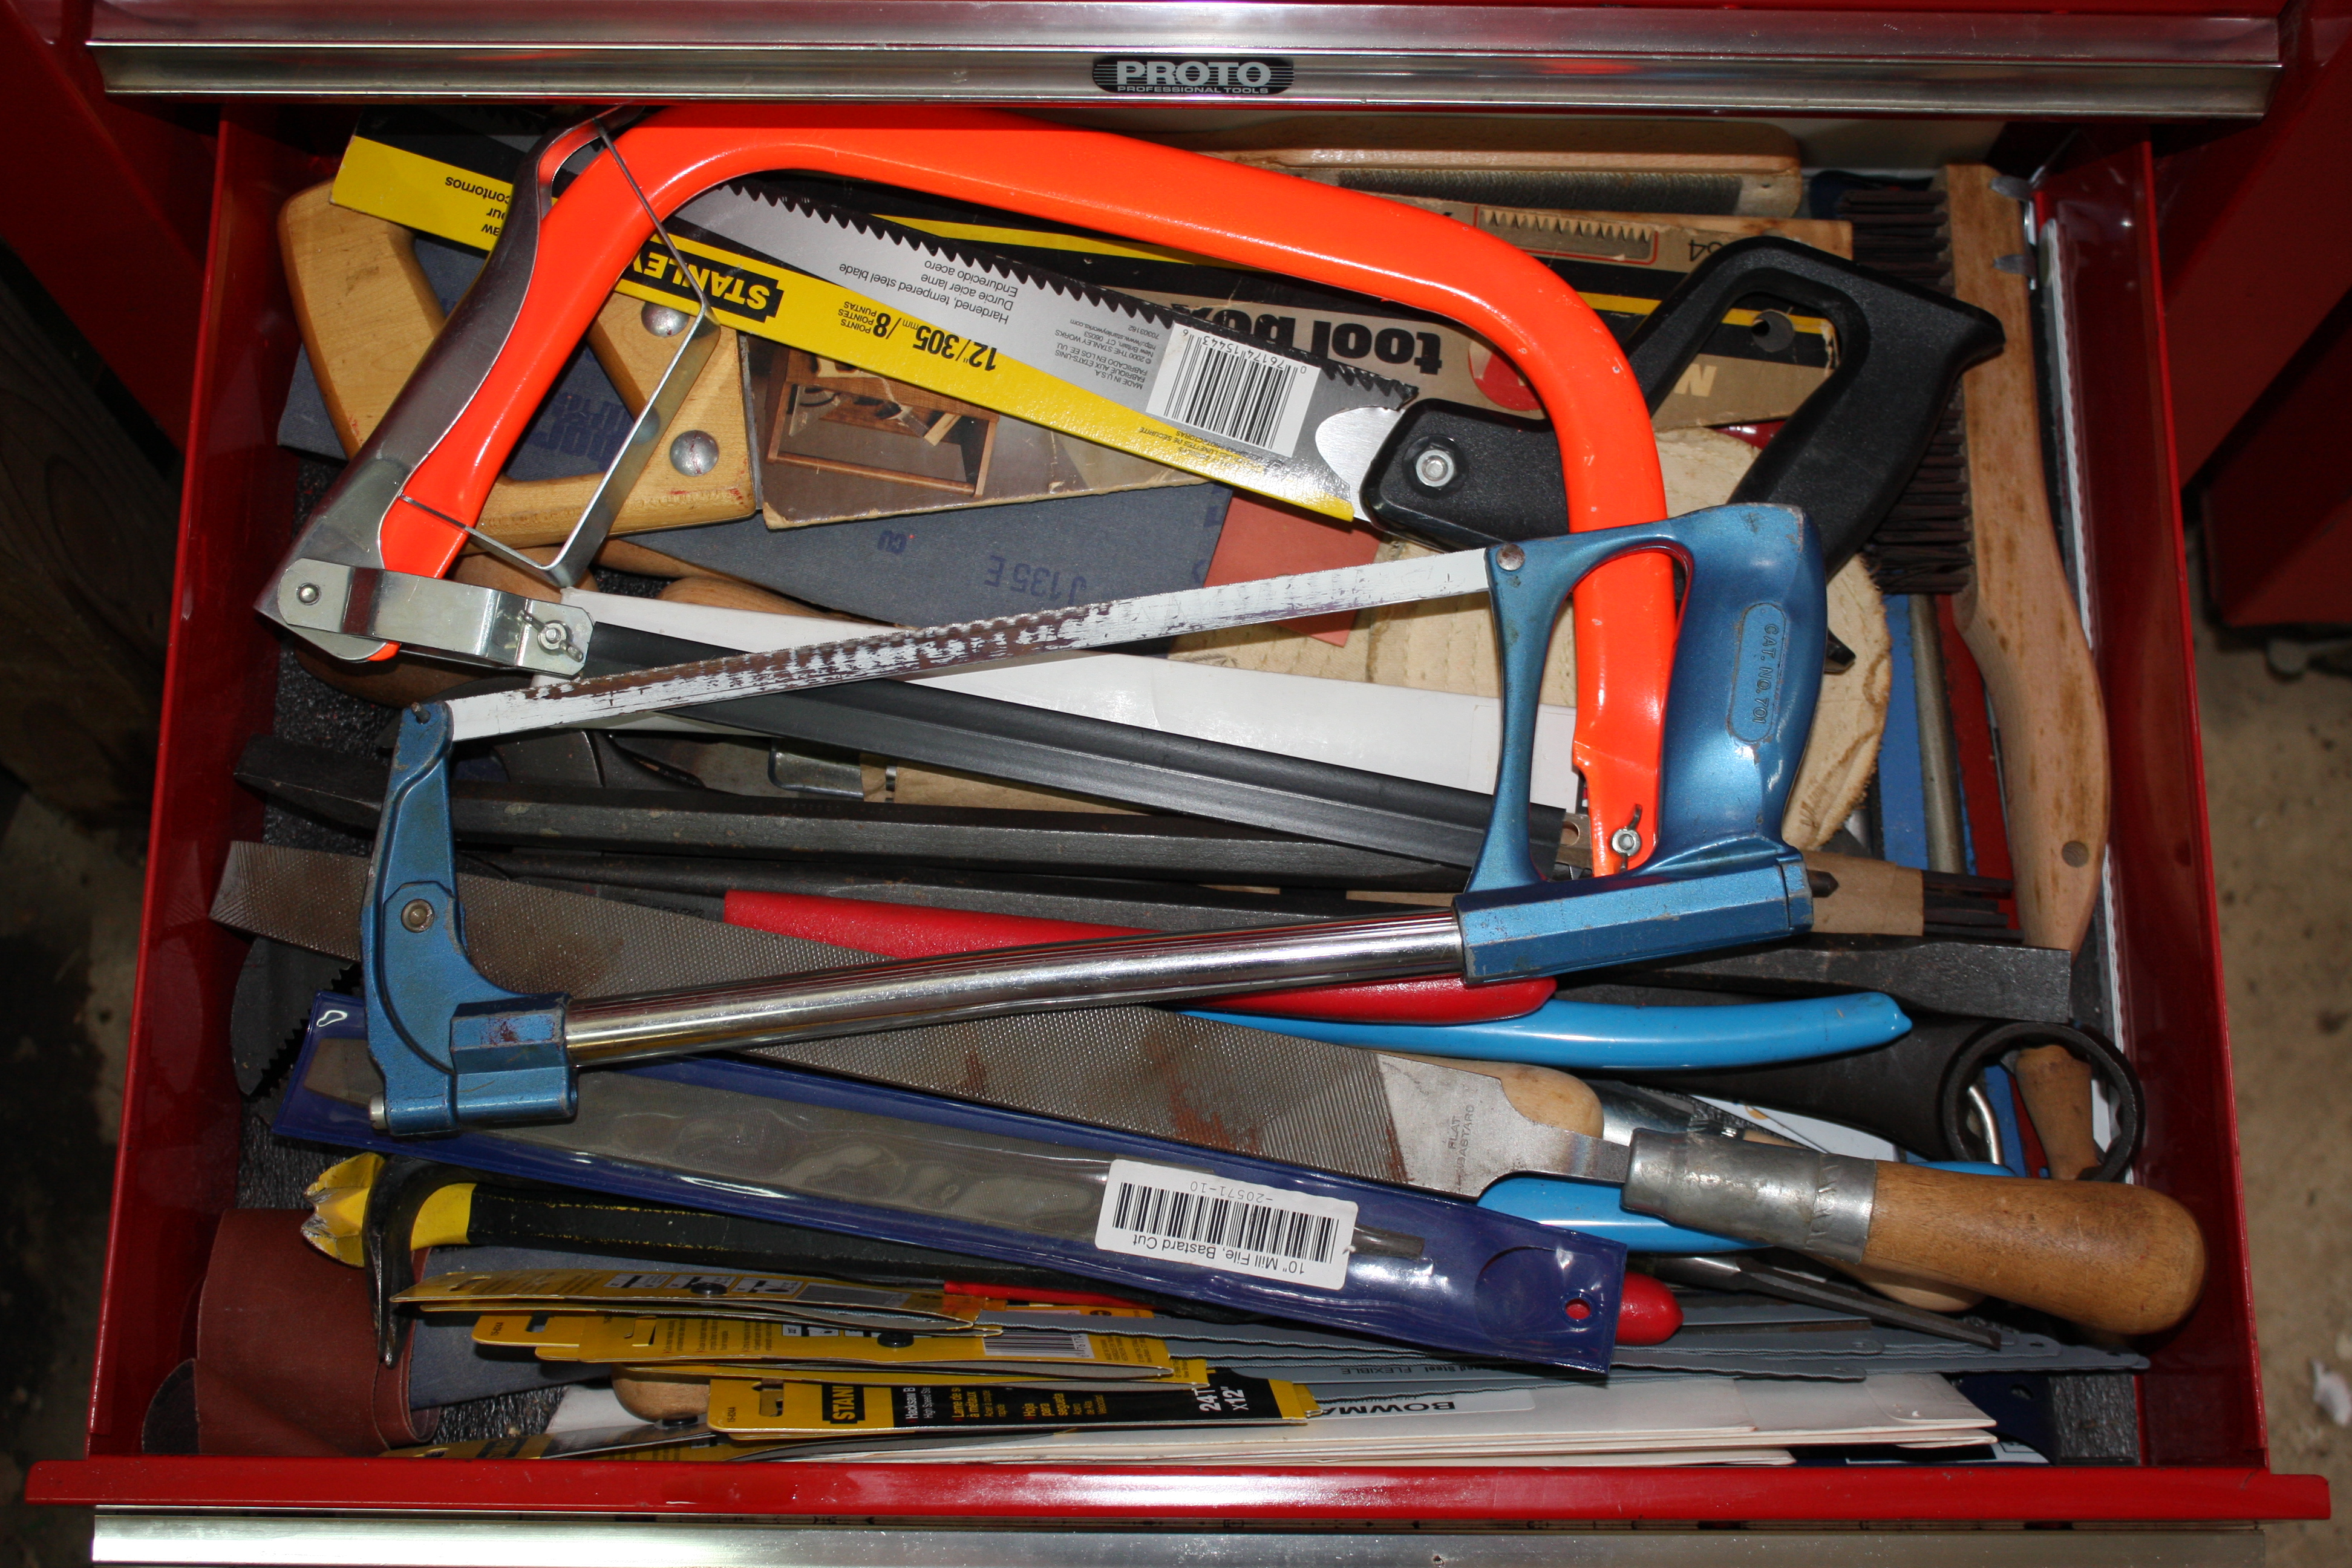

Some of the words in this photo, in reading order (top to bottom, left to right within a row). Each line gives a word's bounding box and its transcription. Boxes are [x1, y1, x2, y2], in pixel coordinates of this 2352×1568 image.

[1117, 60, 1272, 87] PROTO
[1117, 85, 1222, 94] PROFESSIONAL
[837, 263, 869, 281] blade
[923, 258, 955, 276] acero
[869, 272, 897, 289] steel
[919, 273, 948, 290] lame
[955, 269, 1018, 298] Endurecido
[897, 279, 950, 305] tempered
[949, 282, 976, 299] acier
[977, 290, 1014, 310] Durcie
[837, 308, 874, 325] POINTES
[843, 301, 877, 317] PUNTAS
[951, 296, 1010, 324] Hardened,
[839, 318, 872, 334] POINTS
[1069, 318, 1157, 350] http://www.stanleyworks.com
[1181, 328, 1189, 337] 6
[1054, 328, 1081, 342] WORKS
[1083, 330, 1103, 341] 06053
[1106, 337, 1116, 345] CT
[1081, 337, 1113, 353] STANLEY
[1113, 347, 1128, 357] THE
[1117, 340, 1139, 353] Britain,
[1139, 348, 1154, 357] New
[1201, 335, 1240, 355] 15443
[1308, 319, 1445, 376] tool
[1053, 348, 1094, 368] ÉTATS-UNIS
[1080, 350, 1096, 359] LOS
[1128, 352, 1145, 362] 2000
[1245, 348, 1285, 369] 76174
[1093, 368, 1114, 381] U.S.A.
[1094, 361, 1109, 371] AUX
[1106, 358, 1148, 376] FABRICADO
[1122, 378, 1143, 390] MADE
[1759, 623, 1779, 661] CAT.
[1755, 667, 1774, 694] NO.
[1752, 697, 1770, 725] 701
[1189, 1181, 1273, 1204] -20571-10
[1132, 1234, 1158, 1250] Cut
[1161, 1239, 1216, 1259] Bastard
[1220, 1246, 1251, 1266] File,
[1253, 1254, 1278, 1270] Mill
[1282, 1259, 1306, 1275] 10"
[1341, 1366, 1412, 1376] FLEXIBLE
[831, 1385, 855, 1420] STAN
[903, 1397, 918, 1419] Hacksaw
[1321, 1401, 1456, 1417] BOWMA
